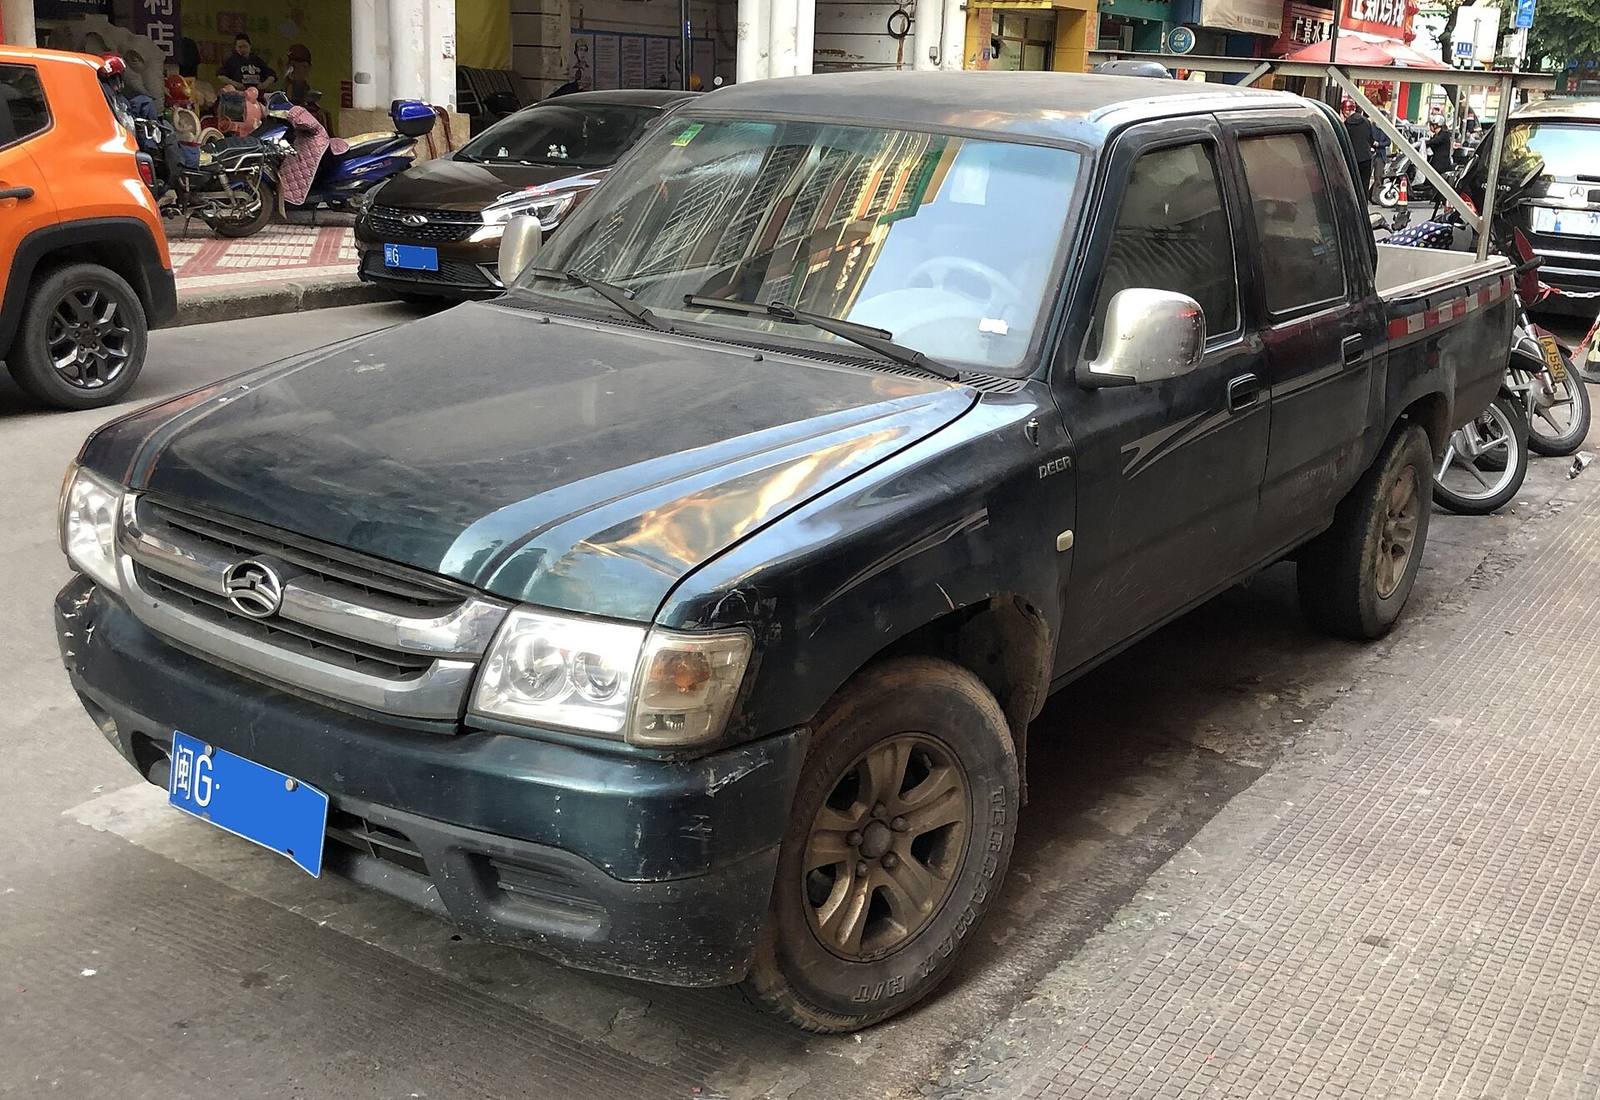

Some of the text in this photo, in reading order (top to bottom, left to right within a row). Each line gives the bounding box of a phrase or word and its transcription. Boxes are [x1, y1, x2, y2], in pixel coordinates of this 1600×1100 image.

[1039, 456, 1071, 479] DEER
[919, 785, 1006, 977] TERRAMAX
[853, 976, 905, 1003] H/T
